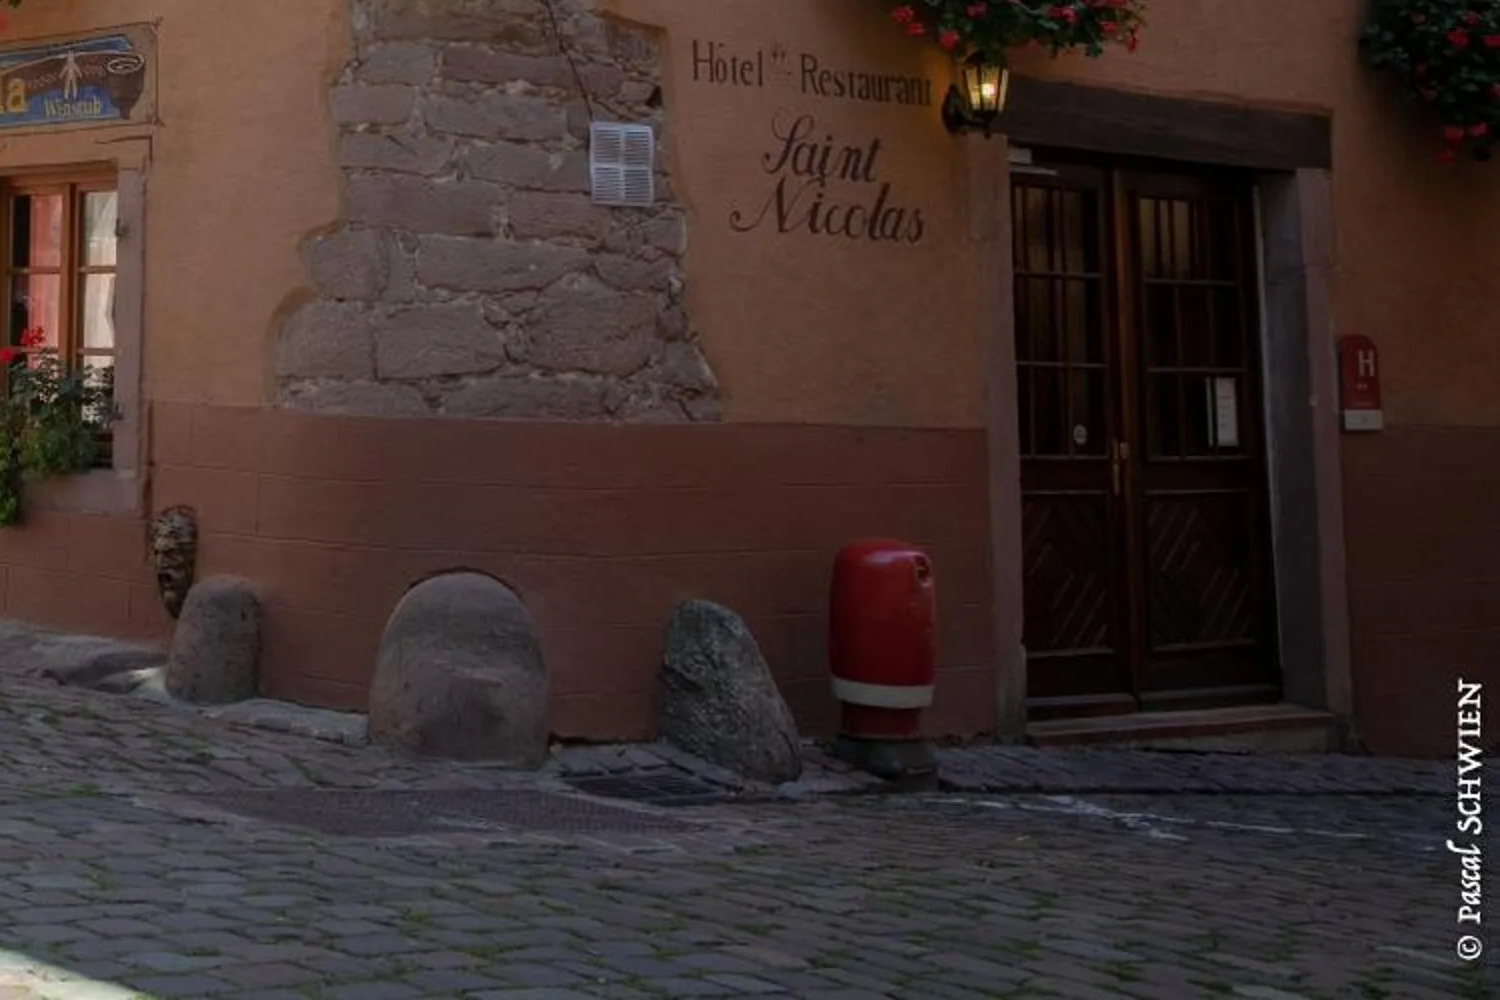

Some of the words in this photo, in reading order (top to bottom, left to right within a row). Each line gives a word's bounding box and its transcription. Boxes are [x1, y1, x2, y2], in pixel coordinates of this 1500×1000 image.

[799, 52, 933, 107] Restaurant
[762, 113, 884, 184] Saint
[729, 176, 925, 245] Nicolas
[1357, 348, 1375, 377] H
